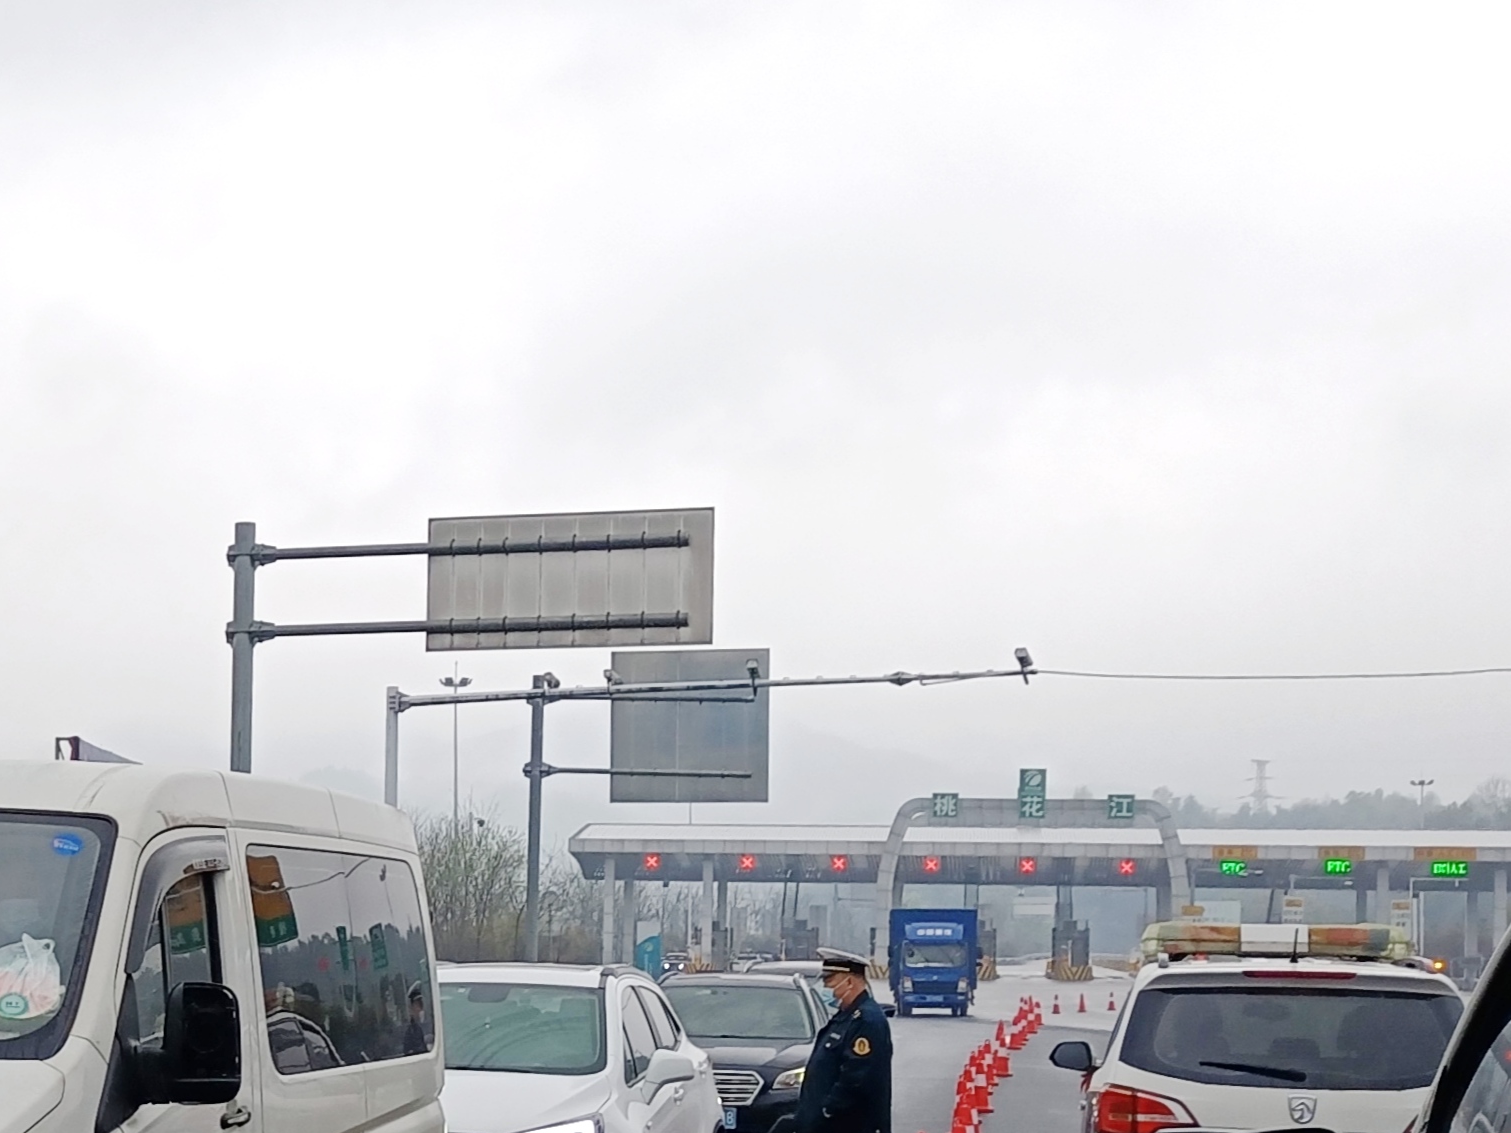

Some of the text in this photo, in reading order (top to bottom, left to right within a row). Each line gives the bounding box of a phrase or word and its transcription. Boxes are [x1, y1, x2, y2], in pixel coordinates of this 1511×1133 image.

[934, 795, 1133, 817] 桃花江
[1327, 861, 1351, 872] ETC
